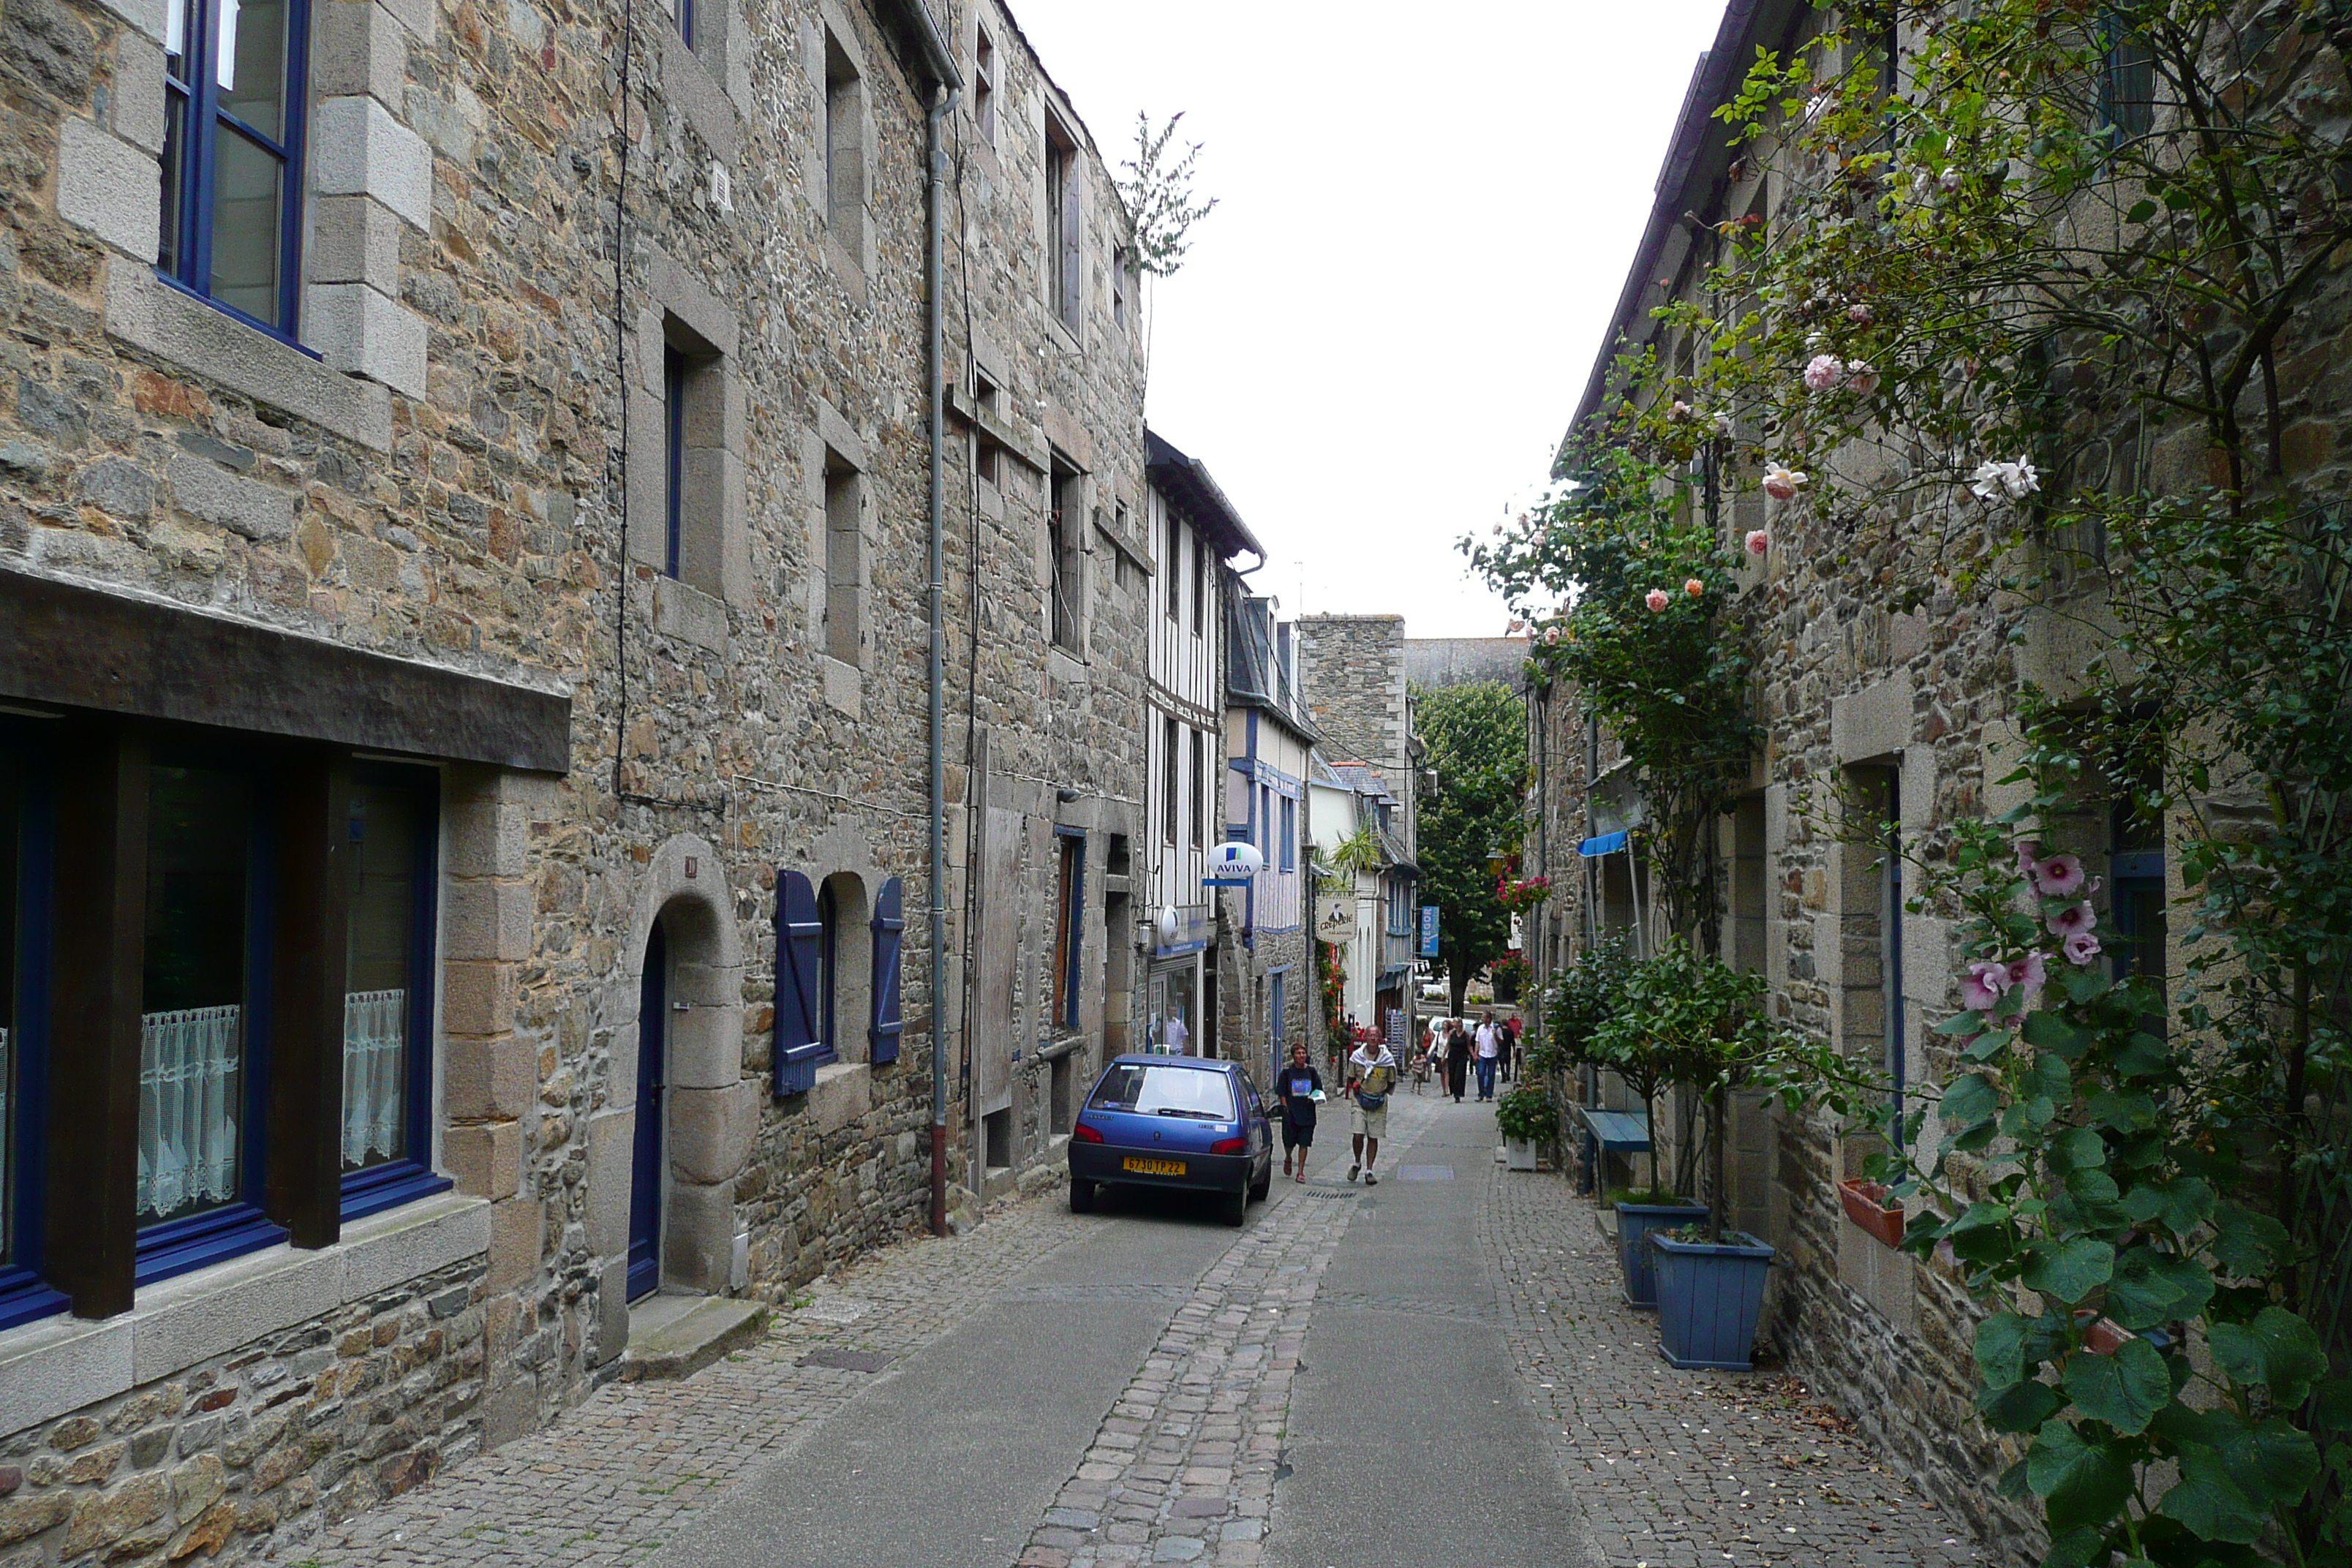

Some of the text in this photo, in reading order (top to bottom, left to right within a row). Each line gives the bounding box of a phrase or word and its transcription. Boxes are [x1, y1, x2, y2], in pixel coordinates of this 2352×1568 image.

[1217, 864, 1251, 872] AVIVA
[1129, 1158, 1180, 1173] 6730 TP 22
